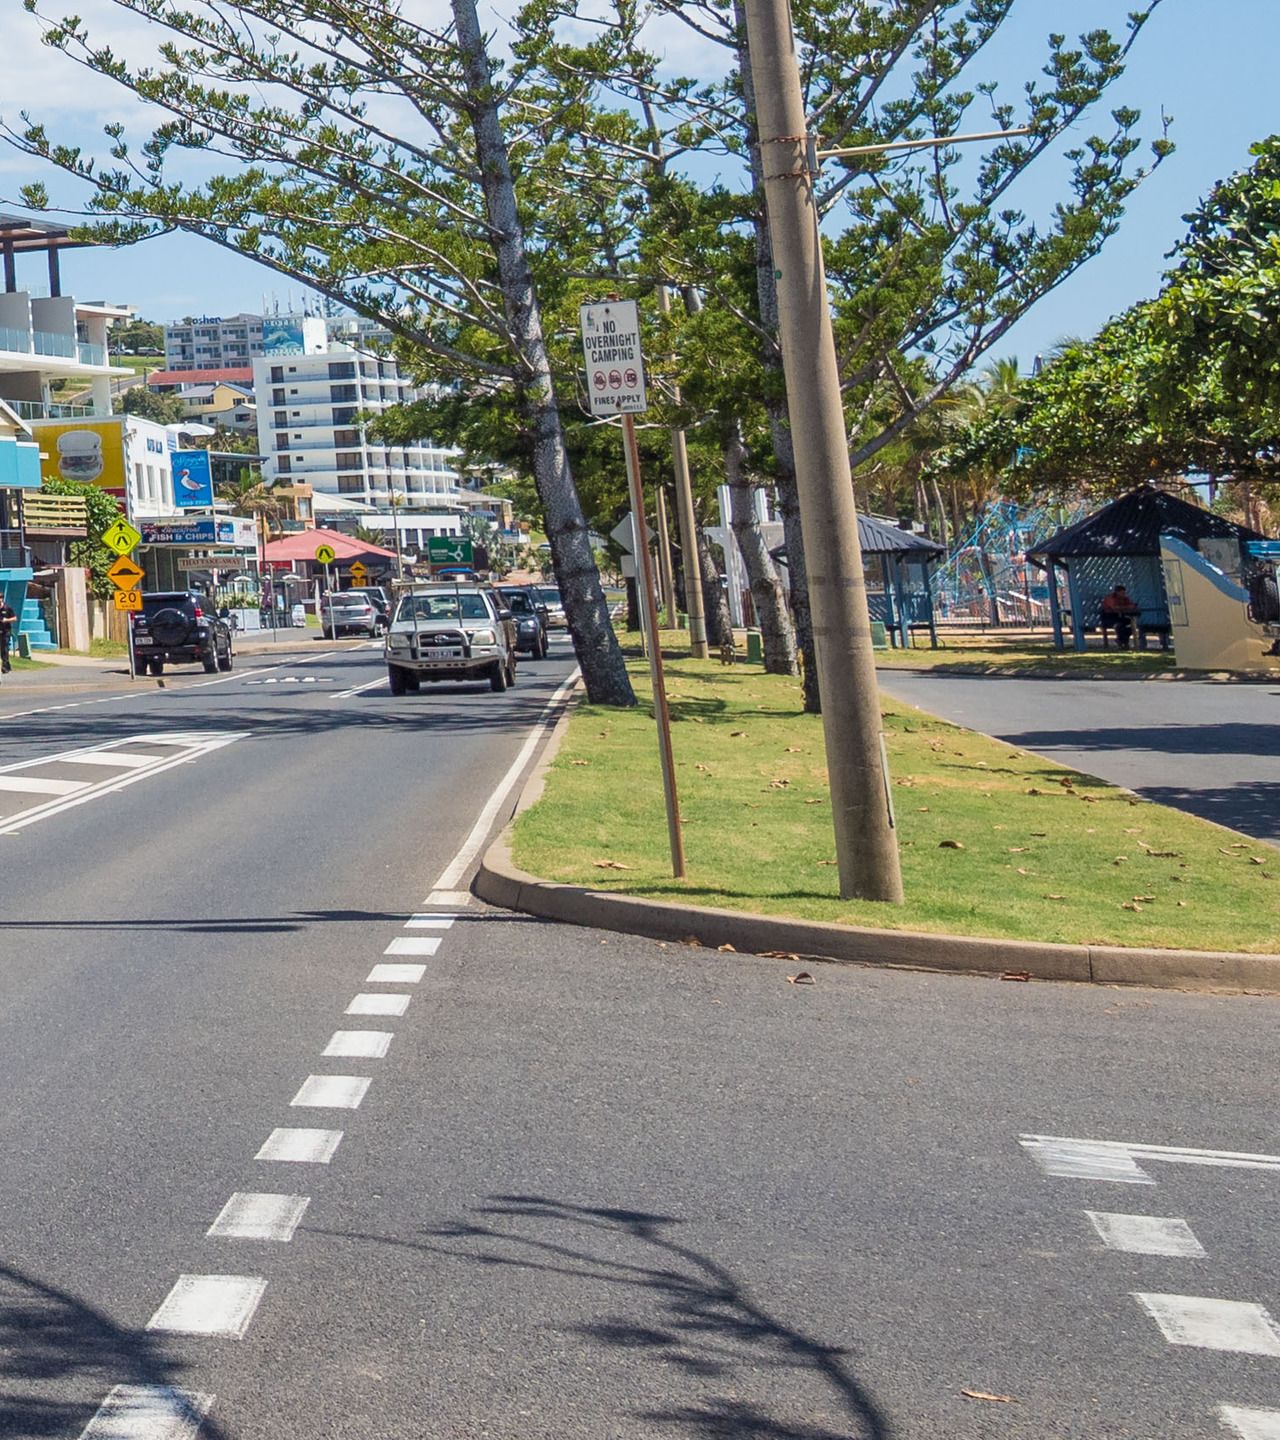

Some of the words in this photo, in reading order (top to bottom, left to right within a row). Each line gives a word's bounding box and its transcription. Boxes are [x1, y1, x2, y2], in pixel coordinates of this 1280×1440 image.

[603, 320, 616, 334] NO
[585, 333, 637, 350] OVERNIGHT
[591, 348, 634, 363] CAMPING
[594, 396, 615, 405] FINES
[616, 394, 641, 404] APPLY
[149, 534, 173, 542] FISH
[185, 532, 214, 541] CHIPS
[119, 592, 137, 603] 20
